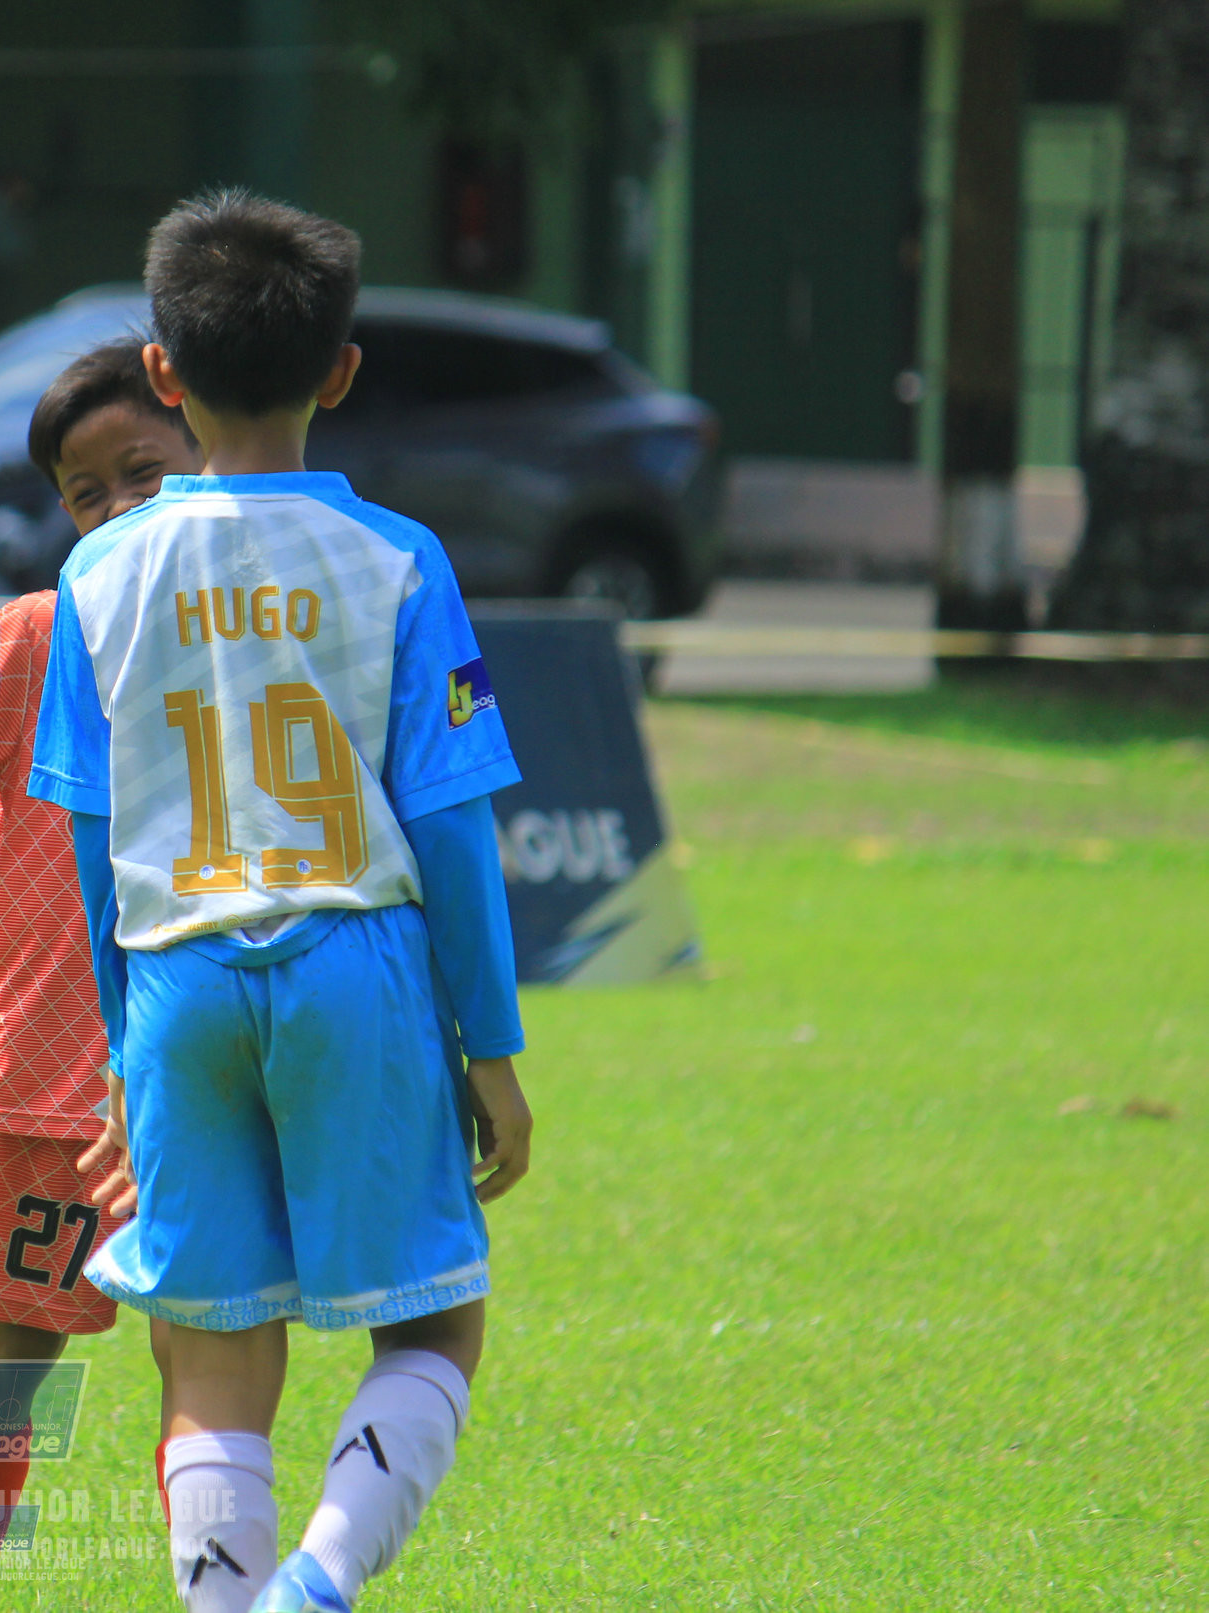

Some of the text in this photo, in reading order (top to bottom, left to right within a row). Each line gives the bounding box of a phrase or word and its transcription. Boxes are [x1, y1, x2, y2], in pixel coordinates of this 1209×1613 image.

[174, 585, 322, 647] HUGO
[162, 682, 370, 897] 19
[4, 1193, 100, 1293] 27
